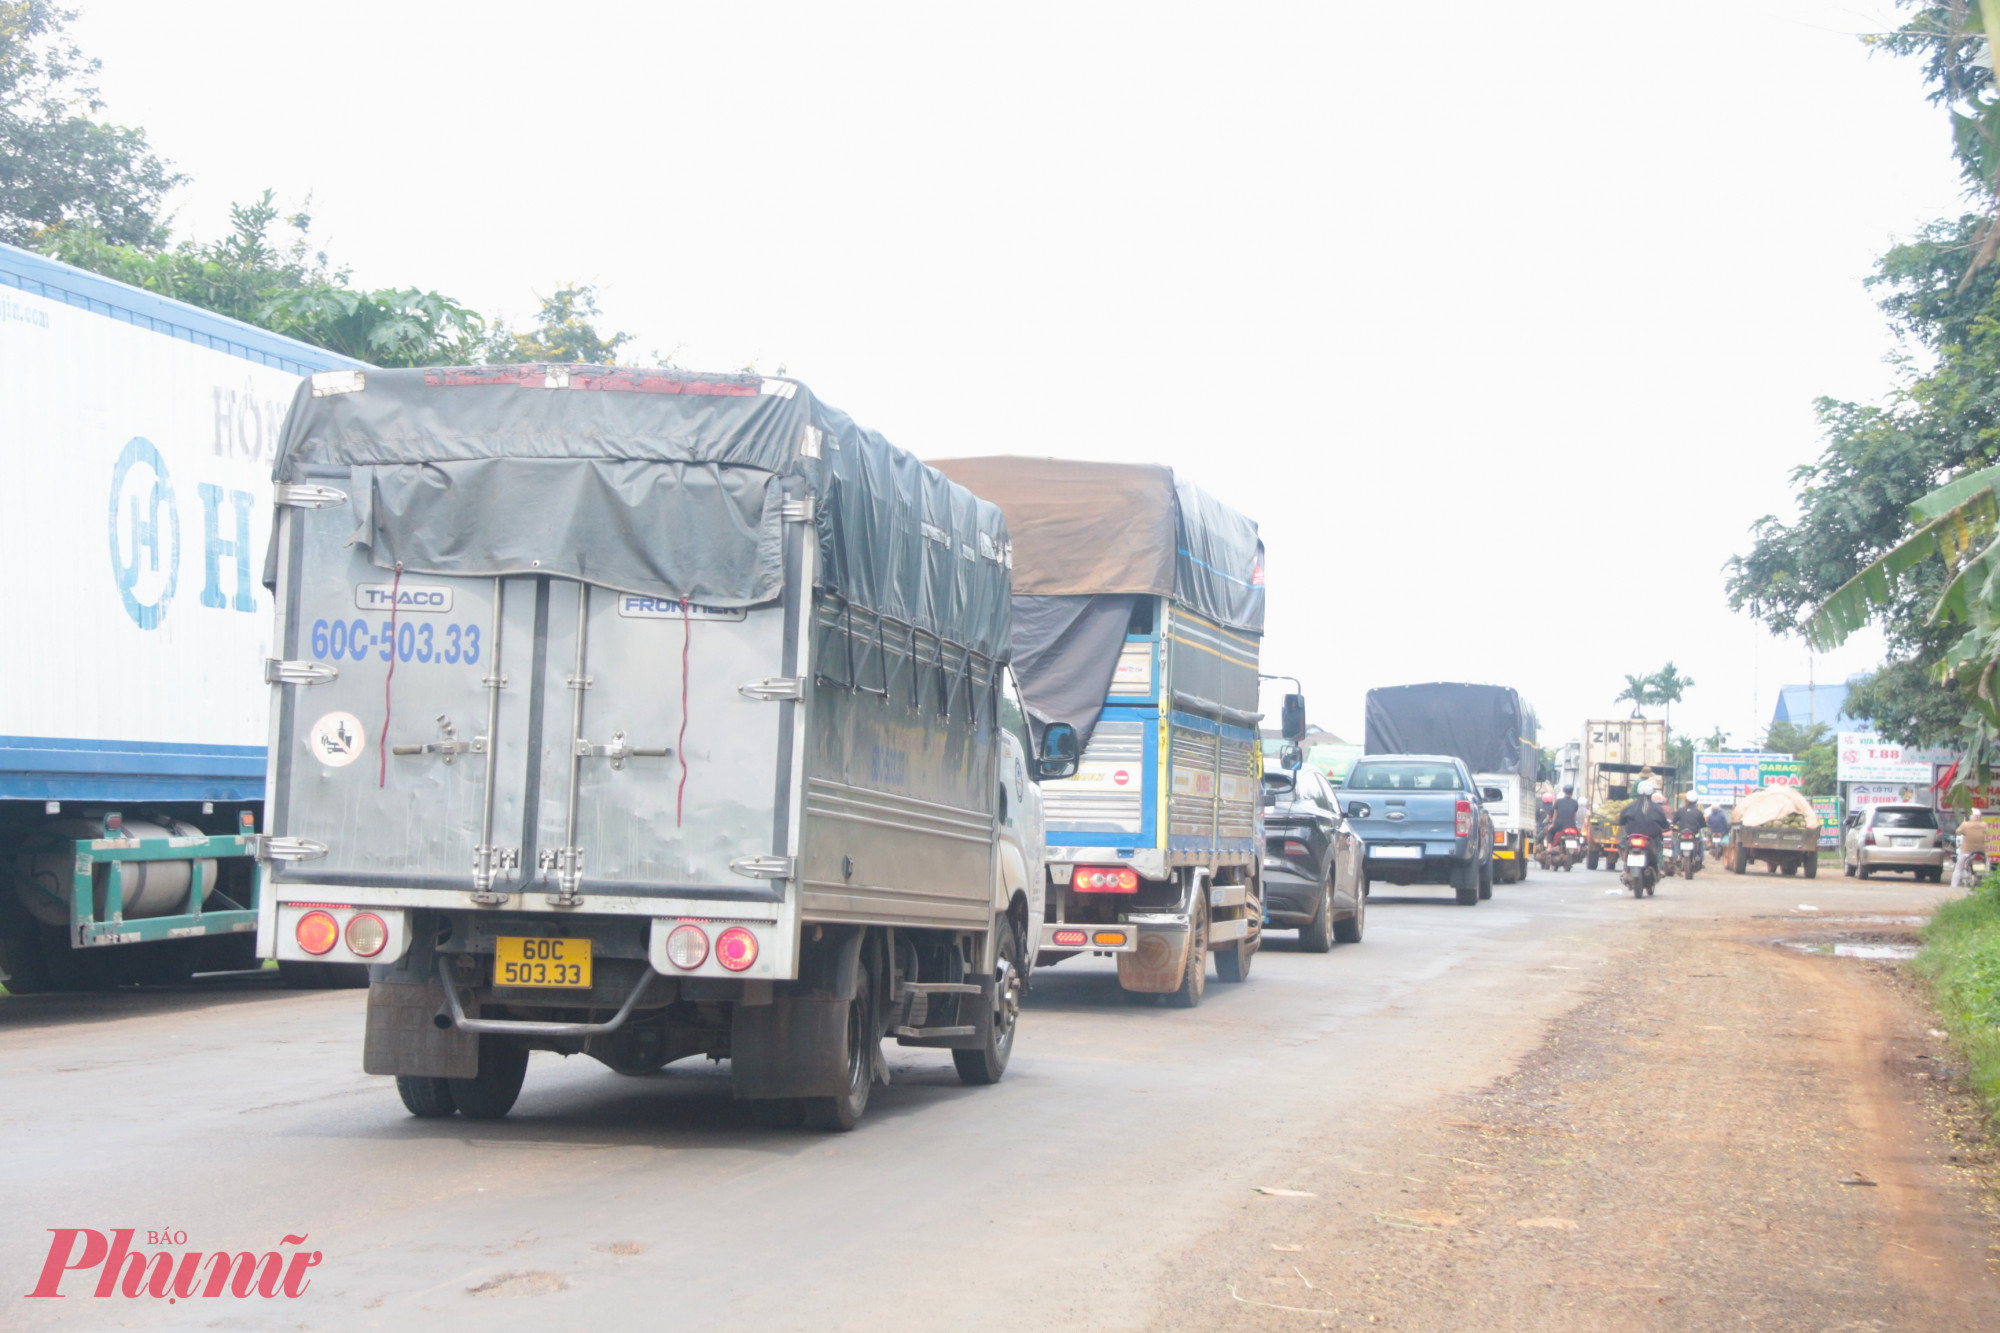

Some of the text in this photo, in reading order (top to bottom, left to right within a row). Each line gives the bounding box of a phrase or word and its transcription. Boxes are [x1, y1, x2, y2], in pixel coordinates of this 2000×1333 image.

[365, 589, 445, 606] THACO
[1868, 749, 1900, 759] T.88
[523, 939, 564, 961] 60C
[505, 962, 581, 985] 503.33
